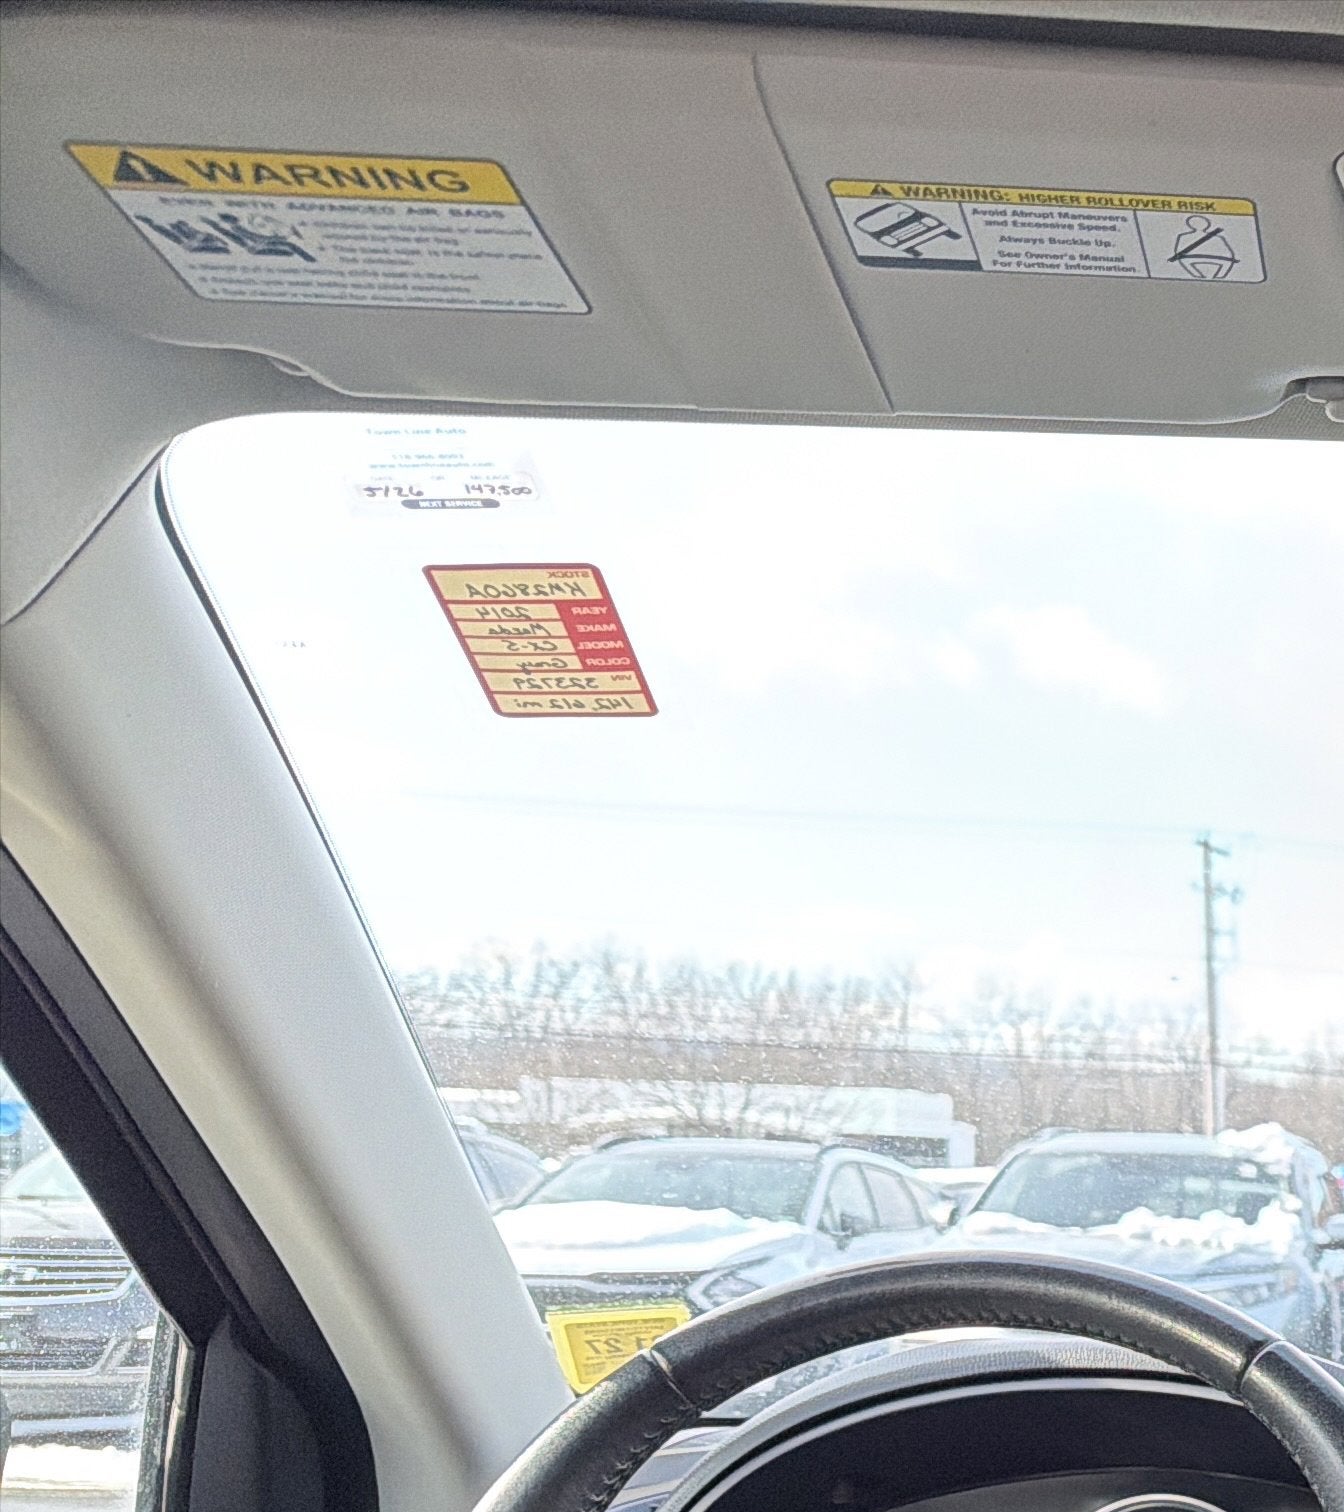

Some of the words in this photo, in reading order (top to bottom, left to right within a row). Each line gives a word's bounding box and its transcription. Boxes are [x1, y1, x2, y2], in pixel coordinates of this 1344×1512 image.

[185, 157, 470, 194] WARNING
[900, 185, 1012, 201] WARNING:
[1018, 192, 1083, 205] HIGHER
[1086, 196, 1177, 211] ROLLOVER
[1180, 201, 1216, 212] RISK
[972, 208, 1007, 217] Avoid
[1012, 209, 1054, 219] Abrupt
[999, 235, 1045, 245] Always
[1049, 237, 1091, 247] Buckle
